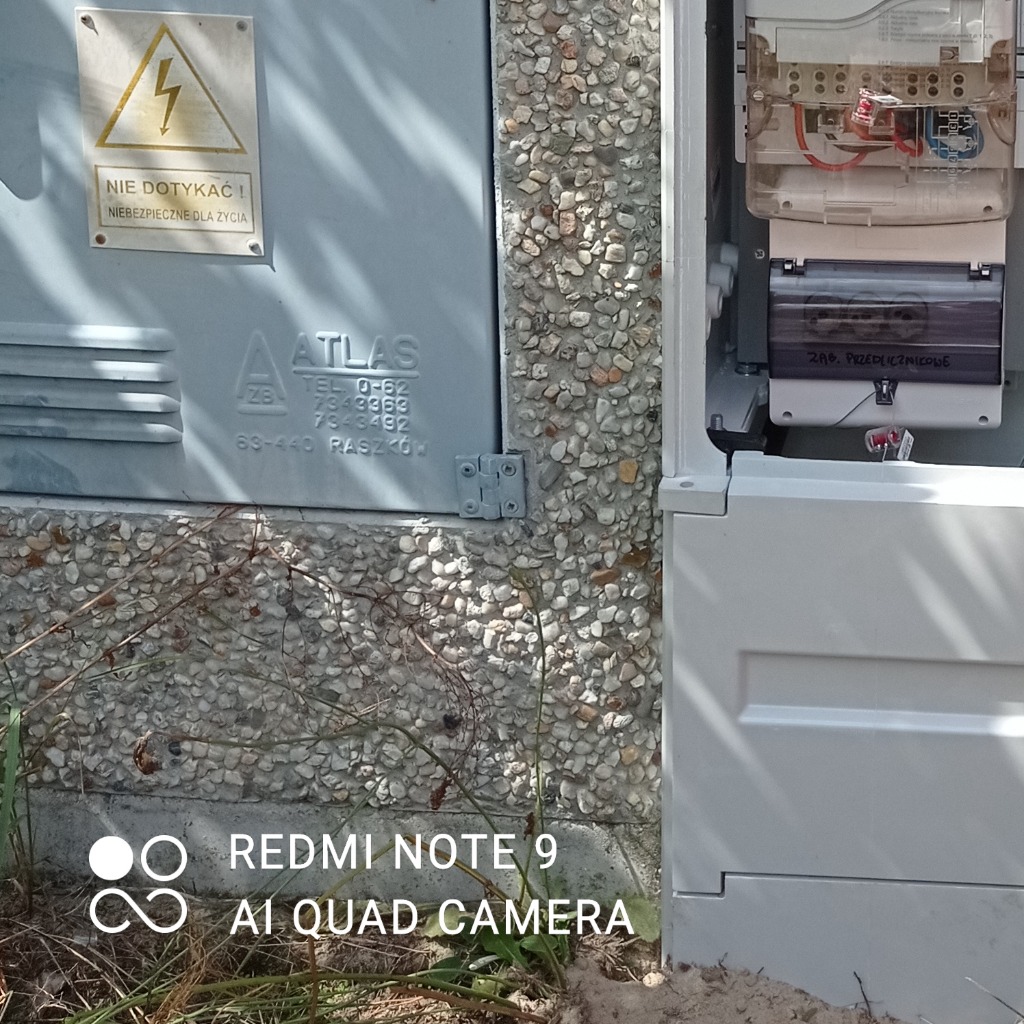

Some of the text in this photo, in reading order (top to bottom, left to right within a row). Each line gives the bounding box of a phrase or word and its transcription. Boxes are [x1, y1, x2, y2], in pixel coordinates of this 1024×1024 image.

[106, 179, 136, 194] NIE
[143, 181, 234, 198] DOTYKAĆ
[108, 207, 248, 224] NIEBEZPIECZNE DLA ŻYCIA
[291, 331, 421, 370] ATLAS
